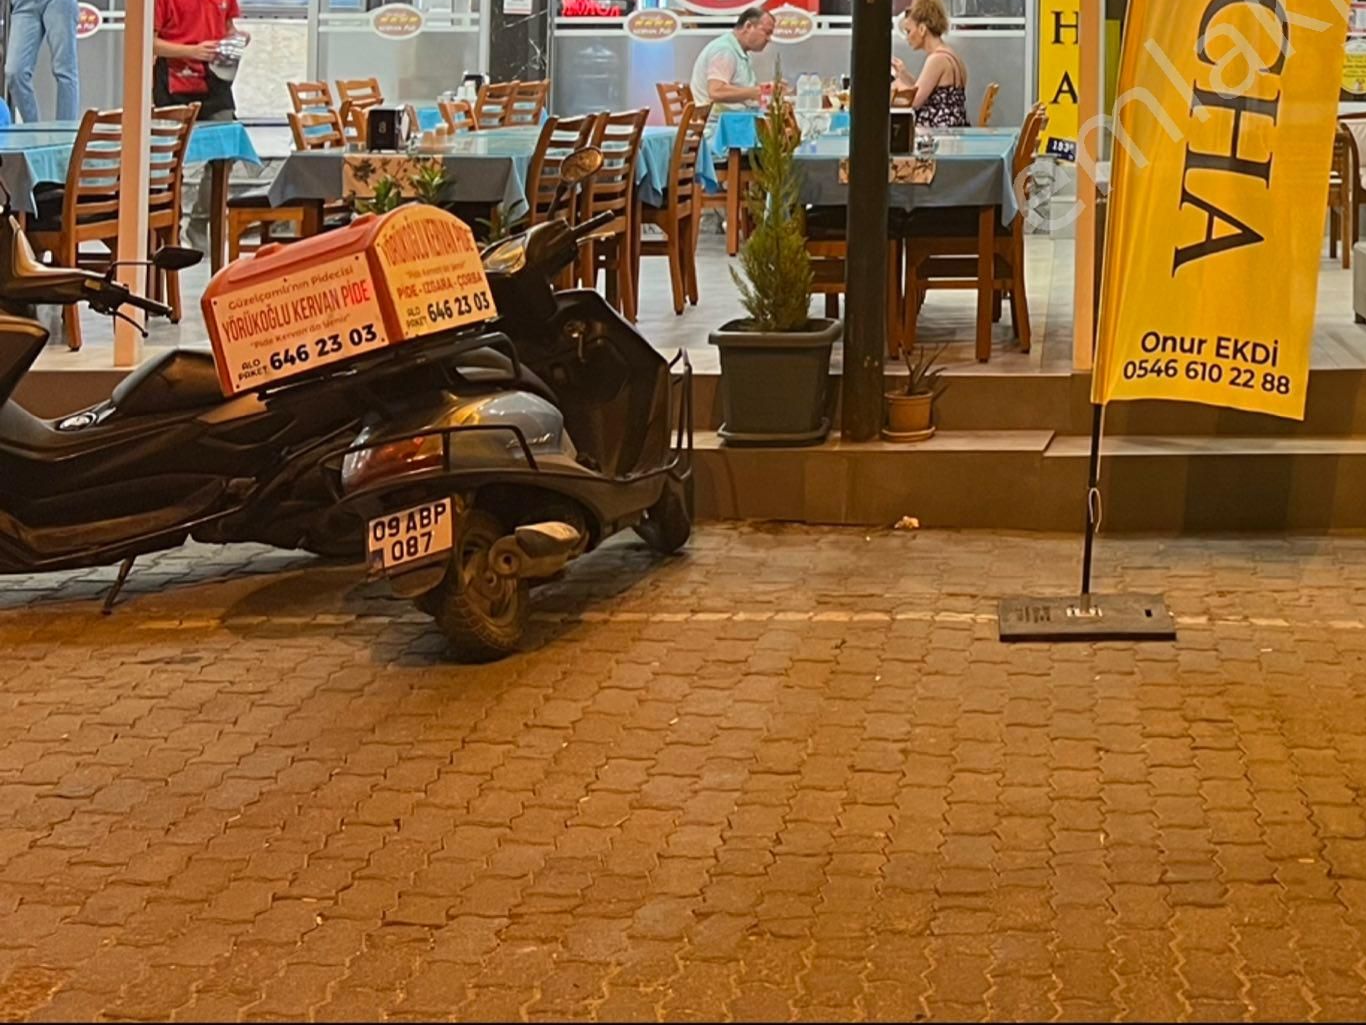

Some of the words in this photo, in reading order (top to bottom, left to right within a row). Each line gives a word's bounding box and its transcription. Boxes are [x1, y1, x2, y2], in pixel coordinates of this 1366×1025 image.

[222, 302, 292, 343] YÖRÜKOĞLU
[291, 287, 341, 323] KERVAN
[341, 279, 371, 307] PİDE
[427, 299, 453, 323] 646
[454, 295, 472, 316] 23
[473, 291, 490, 311] 03
[241, 358, 261, 371] ALO
[269, 344, 310, 371] 646
[315, 333, 343, 358] 23
[349, 323, 378, 347] 03
[1141, 331, 1208, 356] Onur
[1215, 335, 1279, 368] EKDİ
[238, 365, 268, 382] PAKET
[1123, 359, 1178, 380] 0546
[1185, 360, 1223, 383] 610
[1229, 367, 1255, 389] 22
[1261, 372, 1291, 395] 88
[372, 516, 400, 542] 09
[405, 502, 447, 534] ABP
[391, 530, 433, 562] 087
